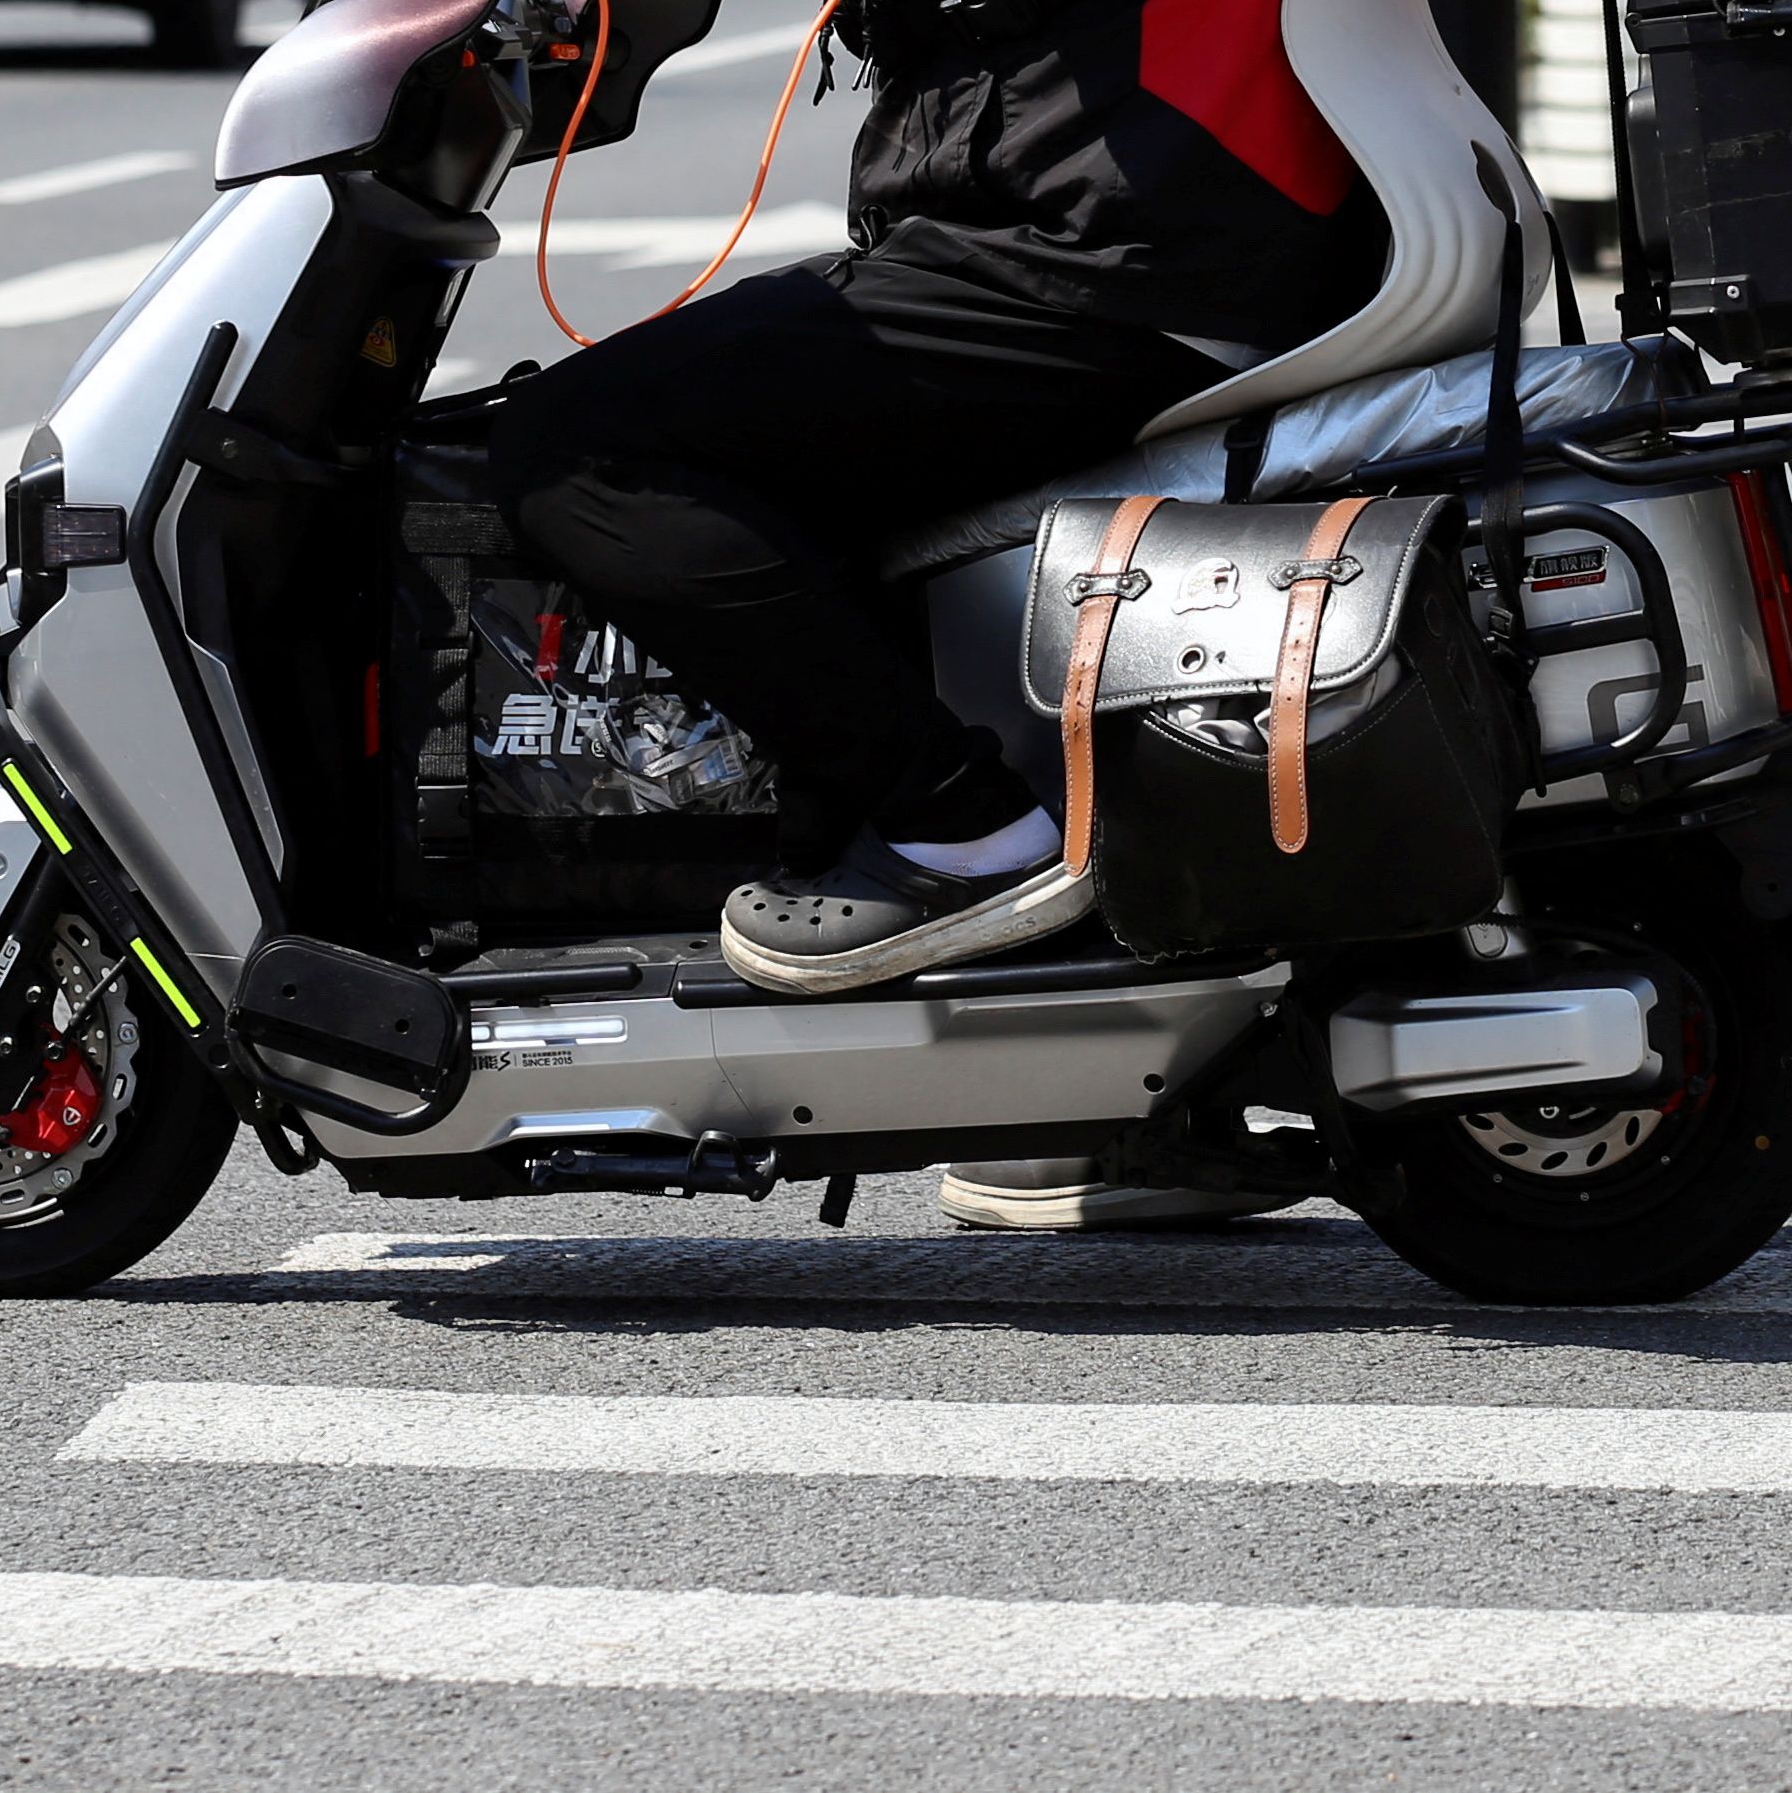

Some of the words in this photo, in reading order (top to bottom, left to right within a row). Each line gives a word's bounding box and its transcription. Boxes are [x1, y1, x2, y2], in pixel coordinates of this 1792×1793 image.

[1539, 552, 1599, 576] 旗舰版
[522, 1058, 551, 1068] SINCE
[552, 1056, 574, 1066] 2015
